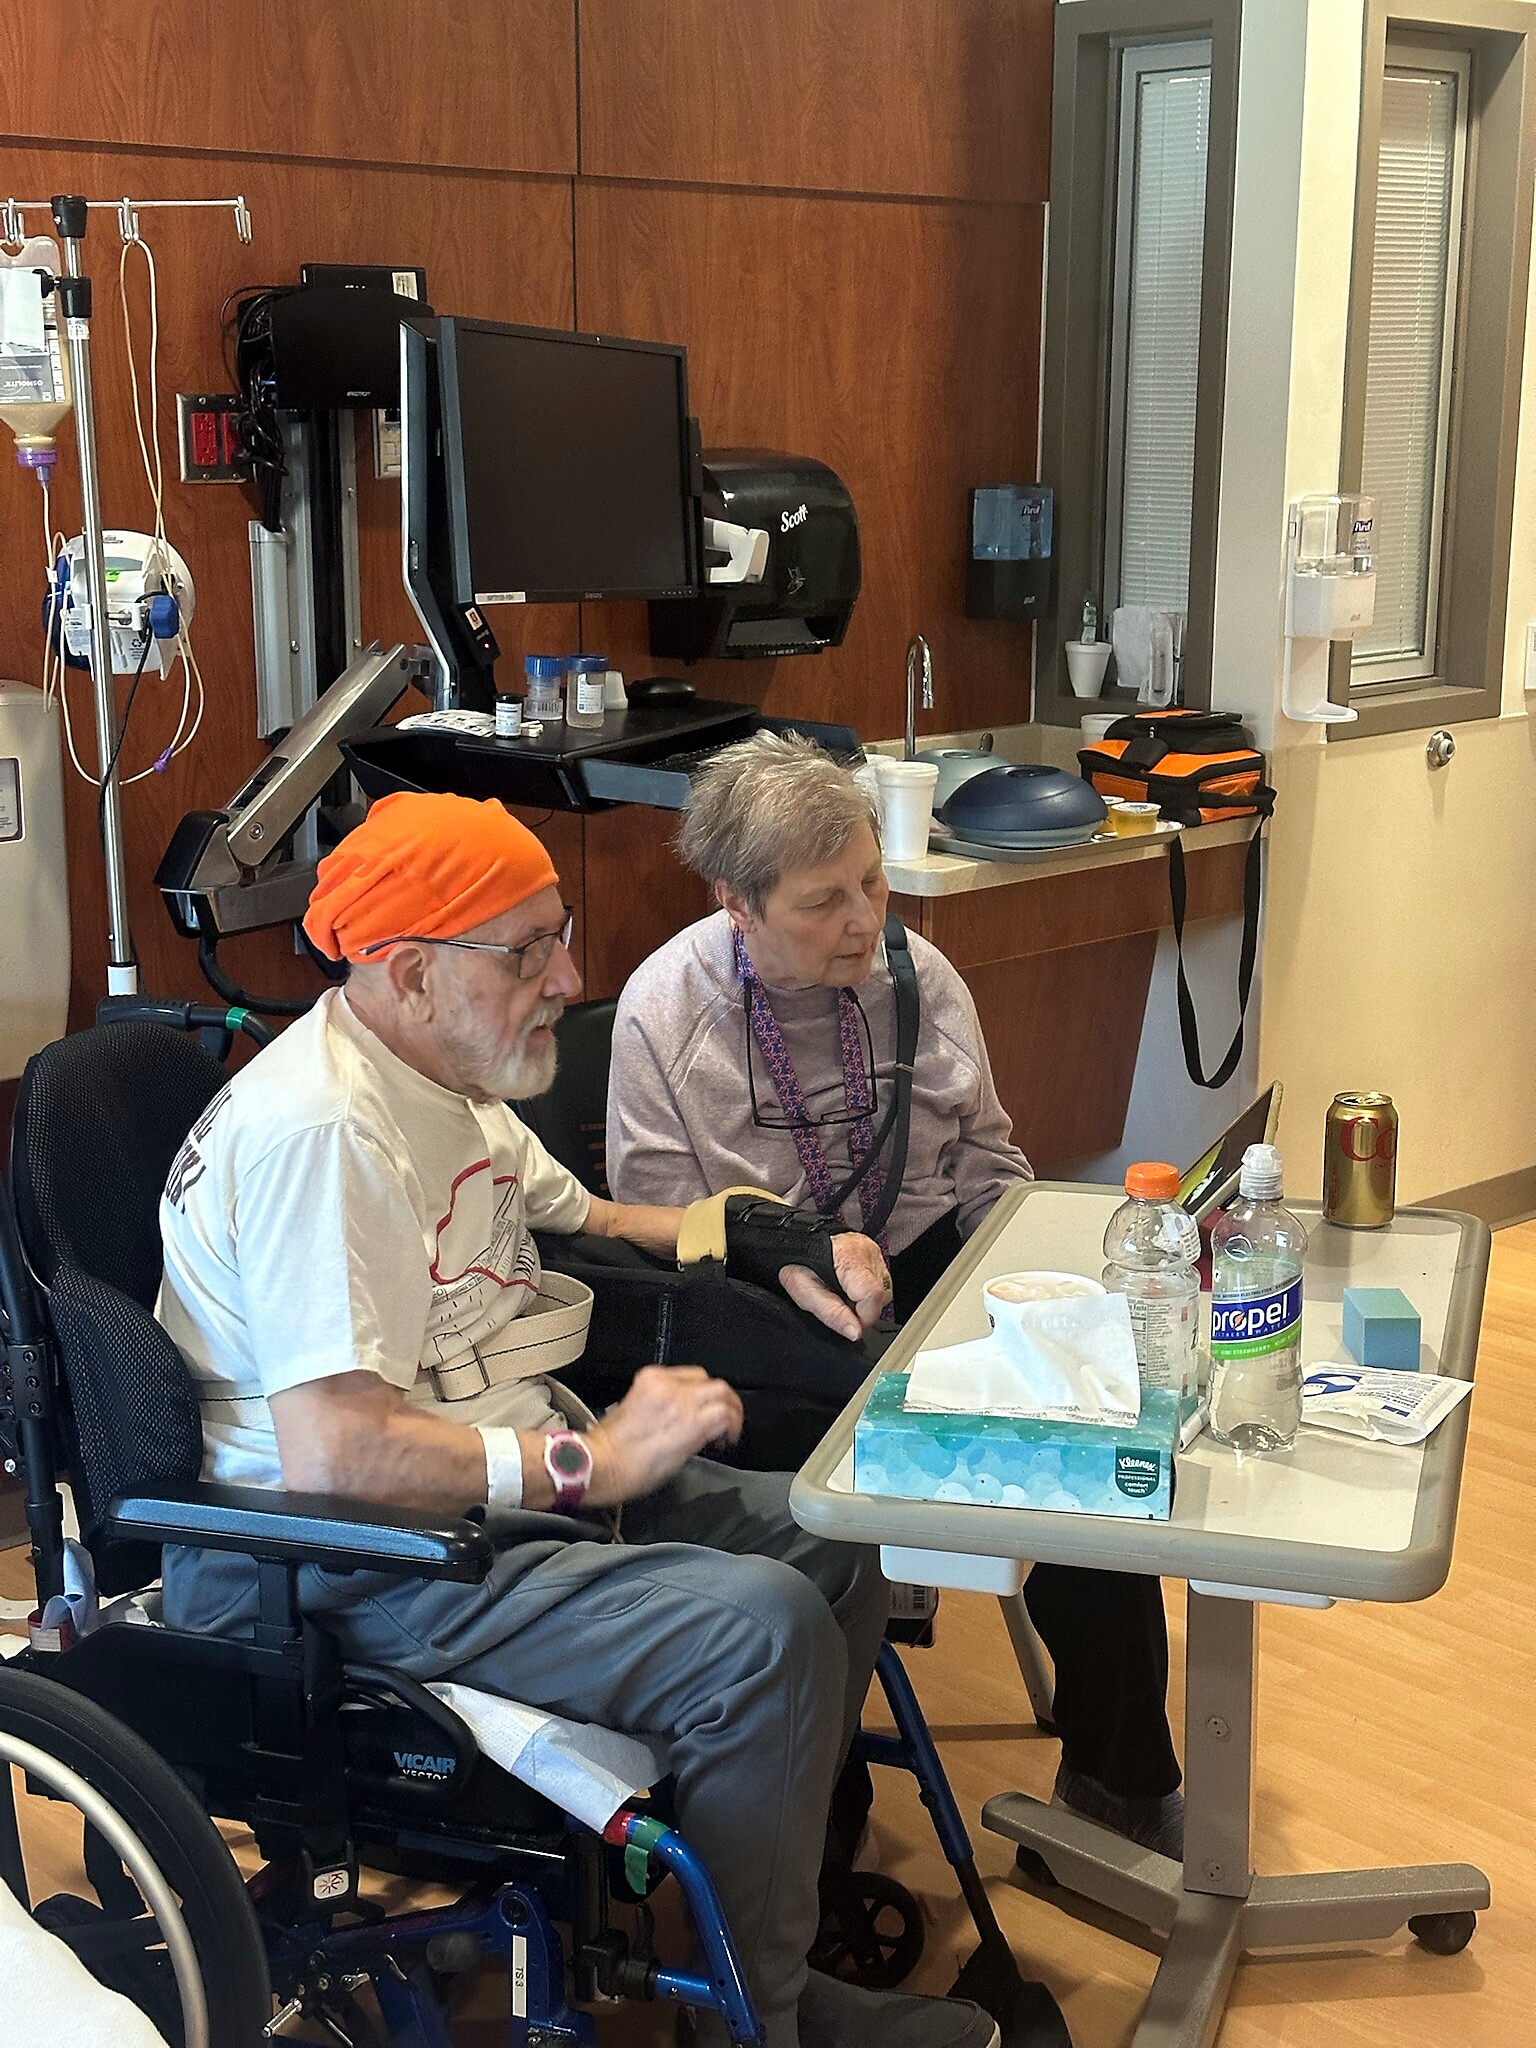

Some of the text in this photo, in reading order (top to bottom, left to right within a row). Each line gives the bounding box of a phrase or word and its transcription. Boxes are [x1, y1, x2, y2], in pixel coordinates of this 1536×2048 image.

[781, 504, 808, 533] Scott
[1212, 1293, 1289, 1337] propel
[1118, 1456, 1157, 1472] Kleenex
[1117, 1474, 1156, 1482] PROFESSIONAL
[393, 1752, 457, 1774] VICAIR
[515, 1967, 524, 1988] TS 3
